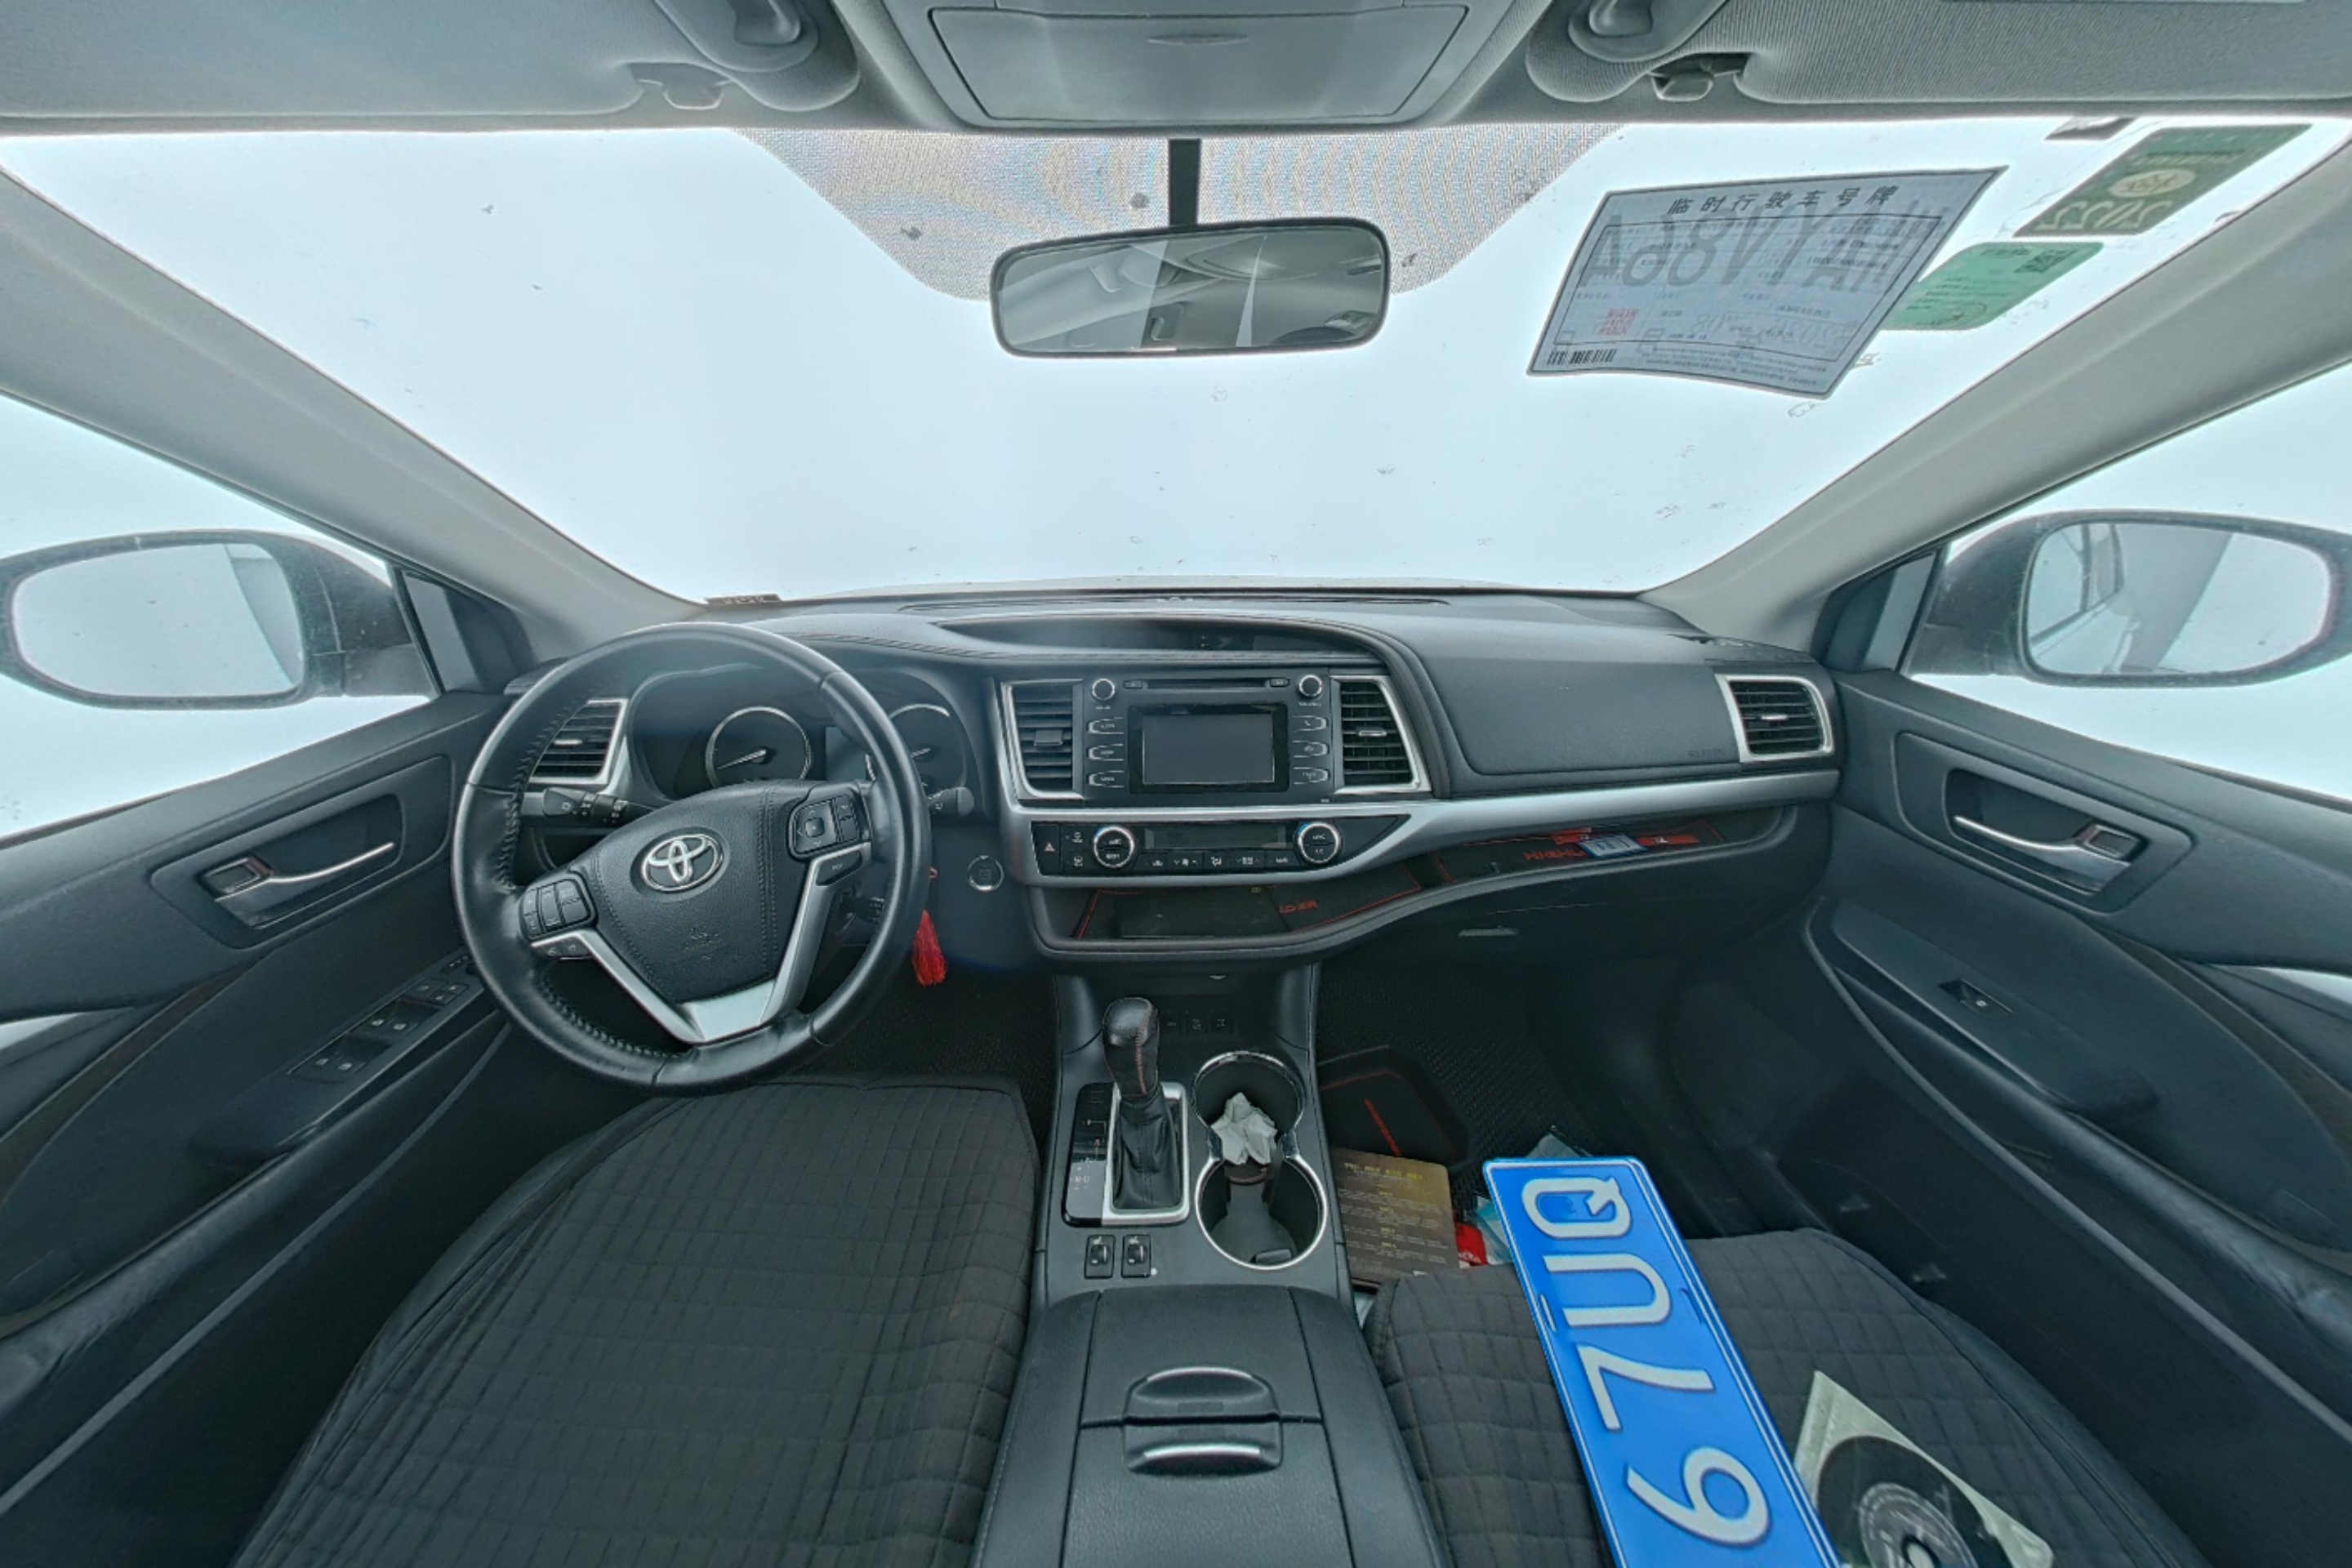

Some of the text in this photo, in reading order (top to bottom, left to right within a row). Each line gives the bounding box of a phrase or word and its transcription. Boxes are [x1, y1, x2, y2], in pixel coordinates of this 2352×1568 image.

[1668, 185, 1899, 215] 临时行驶车号牌
